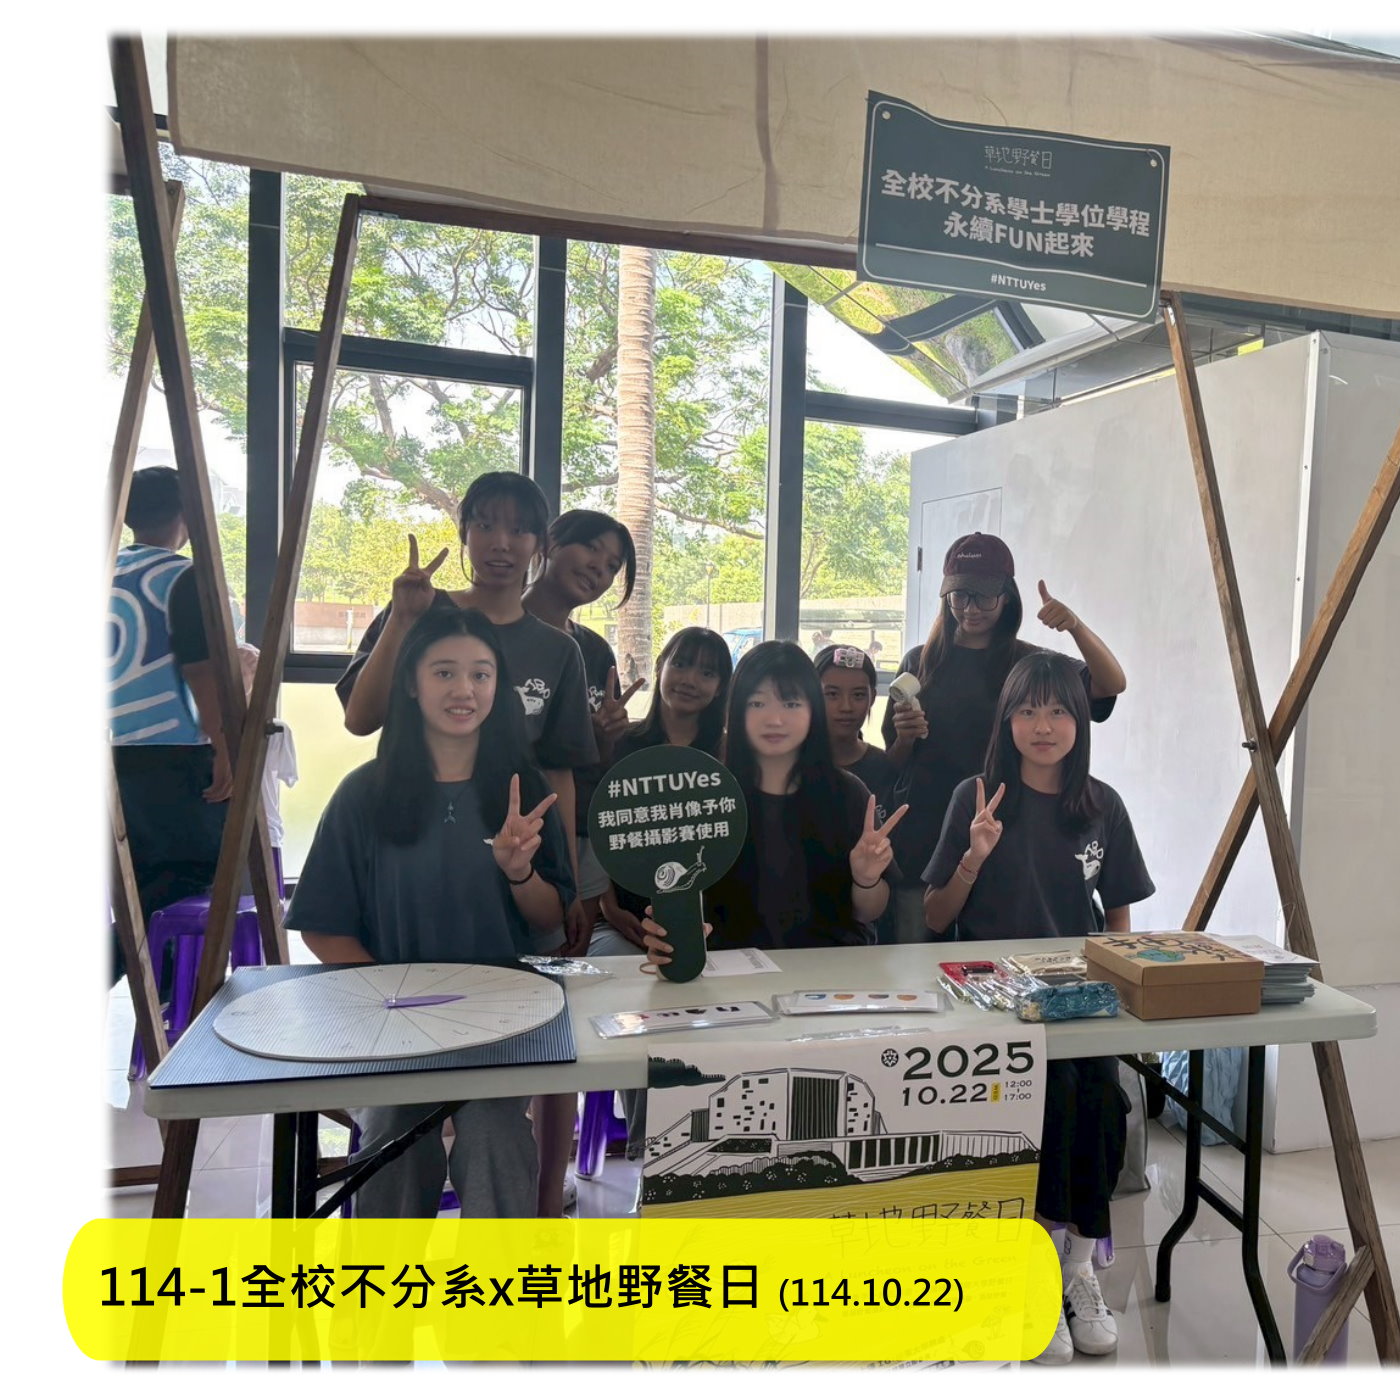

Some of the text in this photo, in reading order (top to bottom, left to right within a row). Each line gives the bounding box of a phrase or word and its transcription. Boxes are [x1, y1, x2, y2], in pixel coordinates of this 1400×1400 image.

[881, 169, 1150, 237] 全校不分系學士學位學程
[944, 210, 1094, 258] 永續FUN起來
[991, 273, 1047, 292] #NTTUYes
[608, 771, 721, 799] #NTTUYes
[598, 796, 736, 828] 我同意我肖像予你
[609, 821, 729, 851] 野餐攝影賽使用
[903, 1041, 1034, 1081] 2025
[903, 1083, 988, 1106] 10.22
[1004, 1092, 1032, 1101] 17:00
[1005, 1080, 1032, 1088] 12:00
